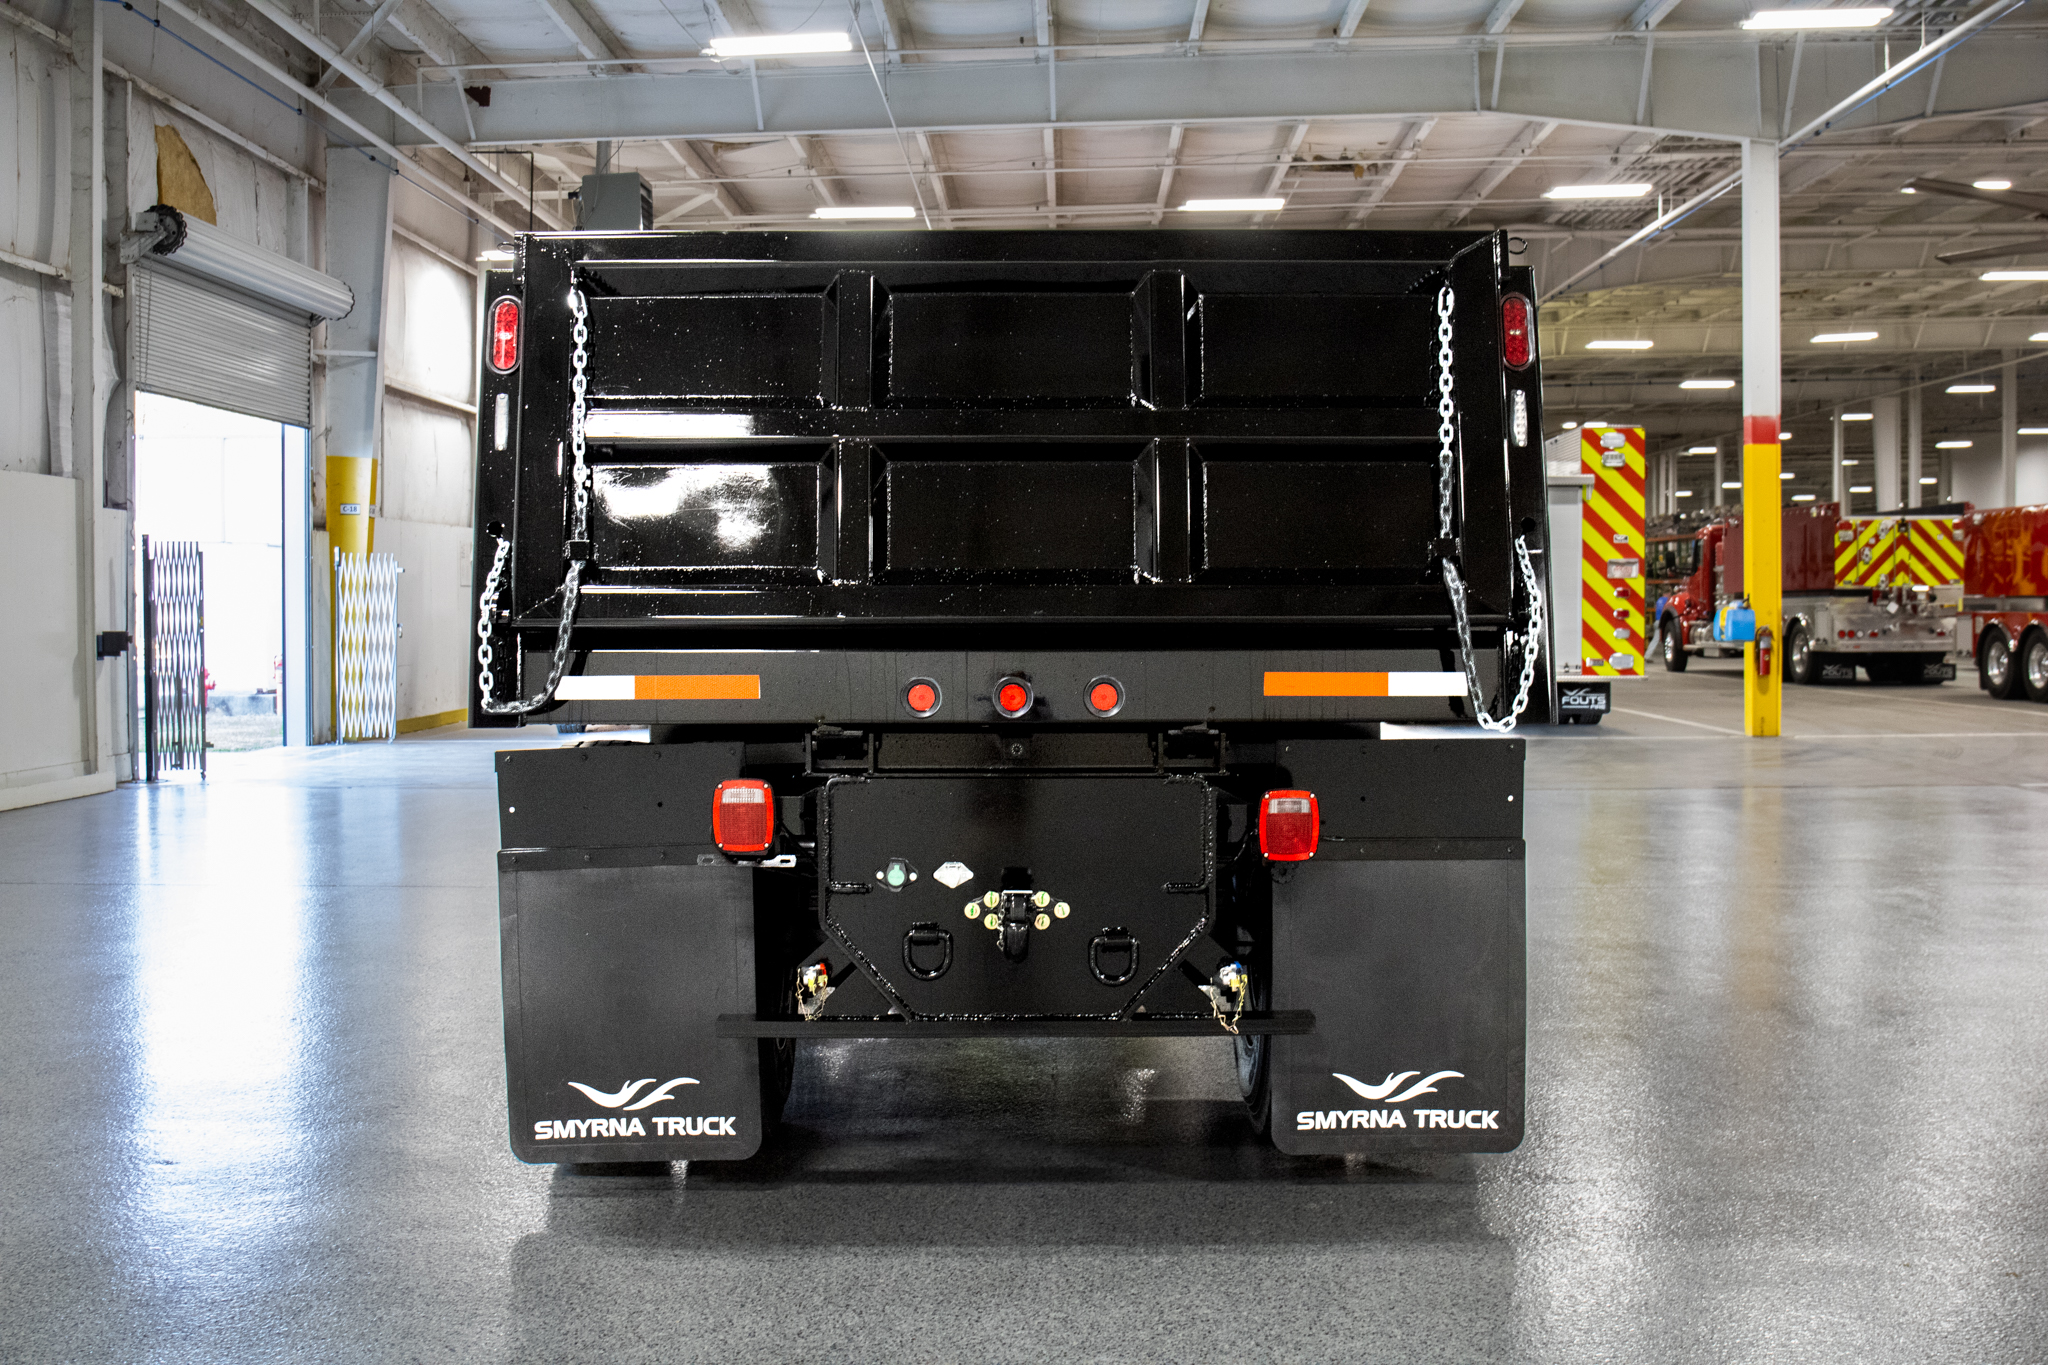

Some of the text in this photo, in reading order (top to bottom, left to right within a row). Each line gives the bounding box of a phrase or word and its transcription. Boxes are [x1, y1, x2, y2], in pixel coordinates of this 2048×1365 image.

[1561, 696, 1606, 705] FOUTS
[534, 1116, 736, 1140] SMYRNA TRUCK
[1296, 1109, 1499, 1131] SMYRNA TRUCK
